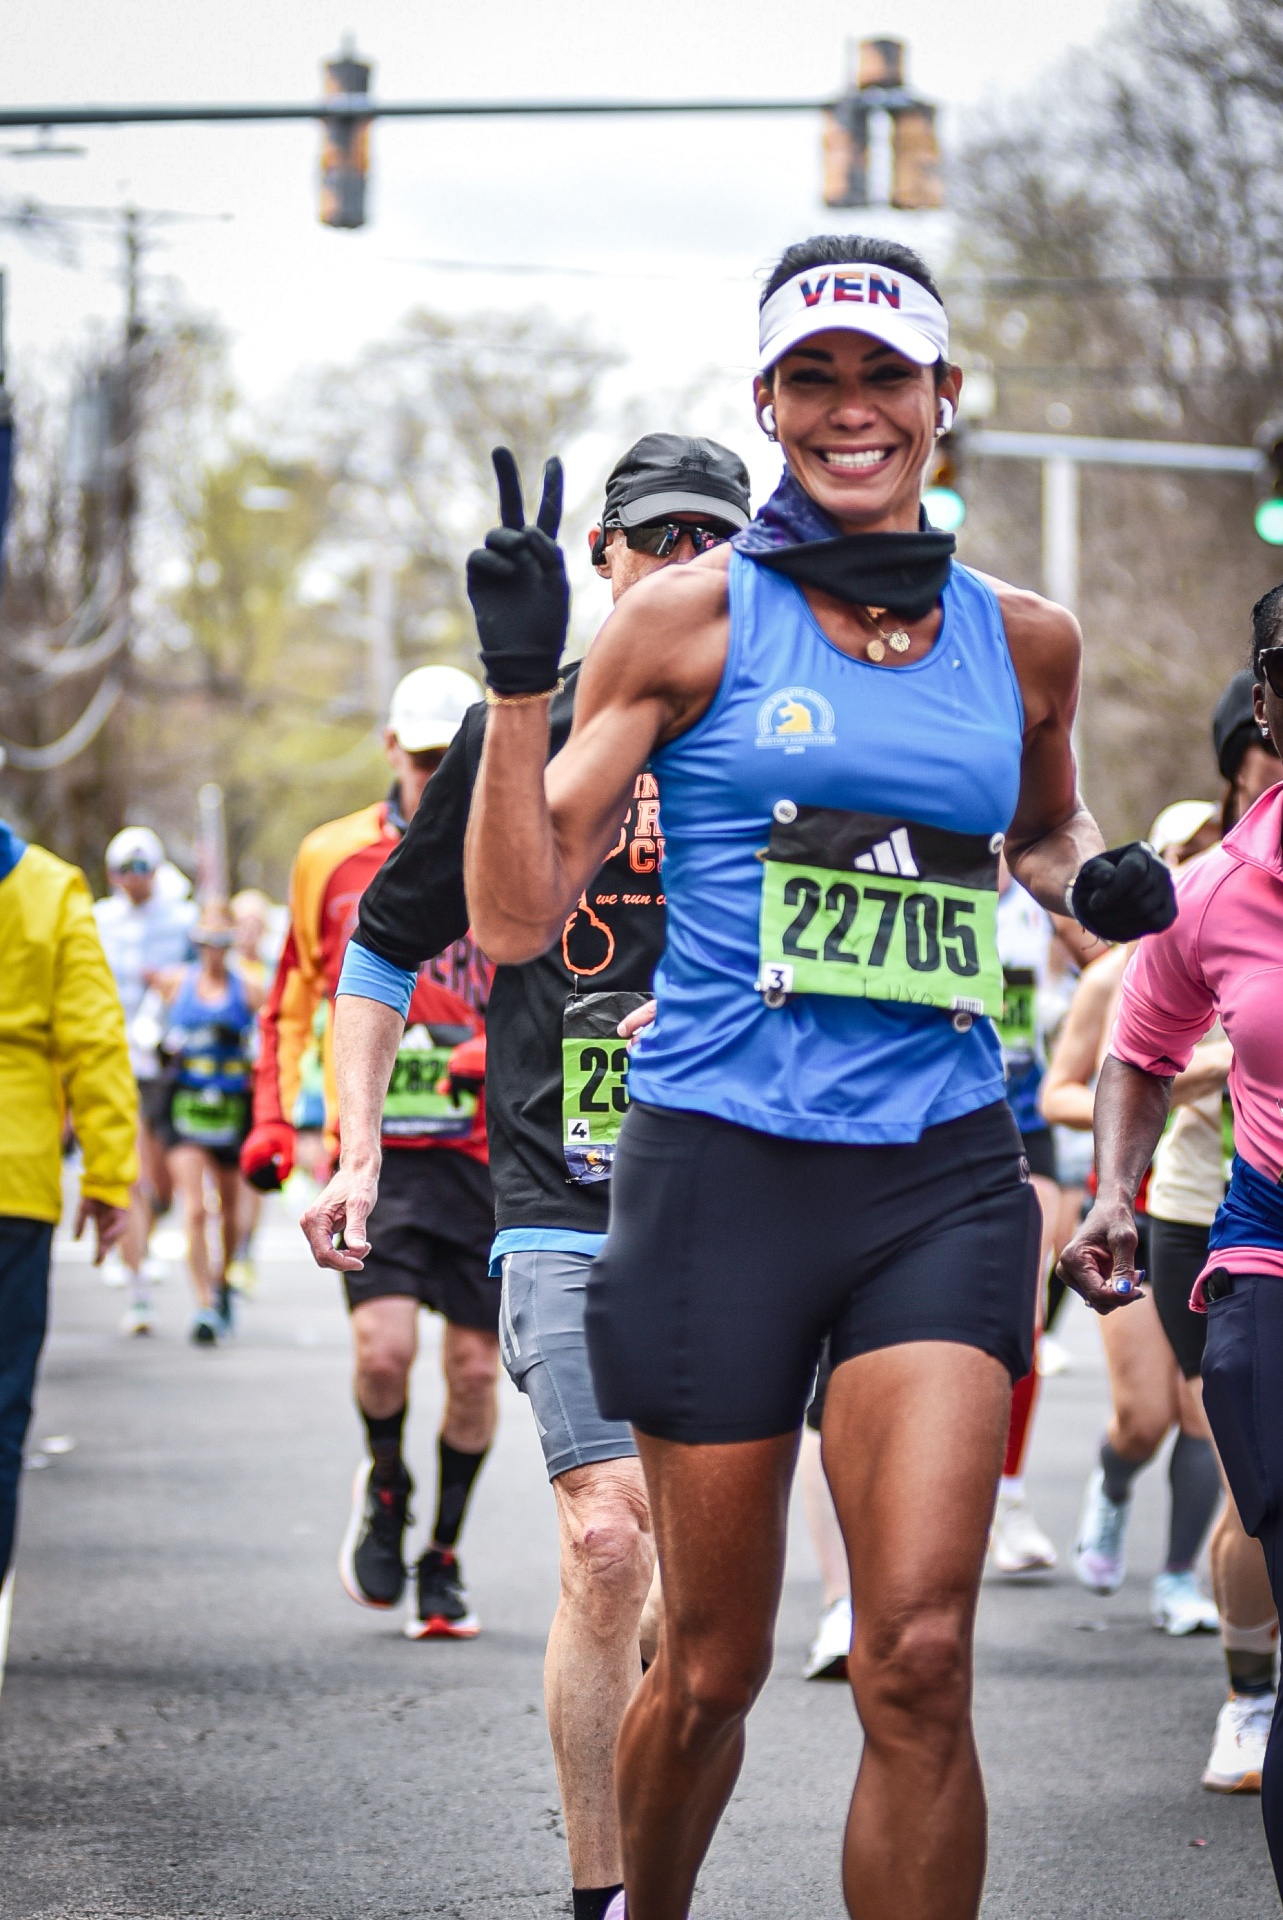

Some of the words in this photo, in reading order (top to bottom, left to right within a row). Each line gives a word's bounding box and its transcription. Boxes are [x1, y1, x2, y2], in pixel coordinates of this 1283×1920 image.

[799, 271, 901, 310] VEN
[595, 893, 618, 905] we
[621, 893, 652, 905] run
[782, 877, 980, 977] 22705
[768, 969, 784, 992] 3
[570, 1122, 588, 1139] 4
